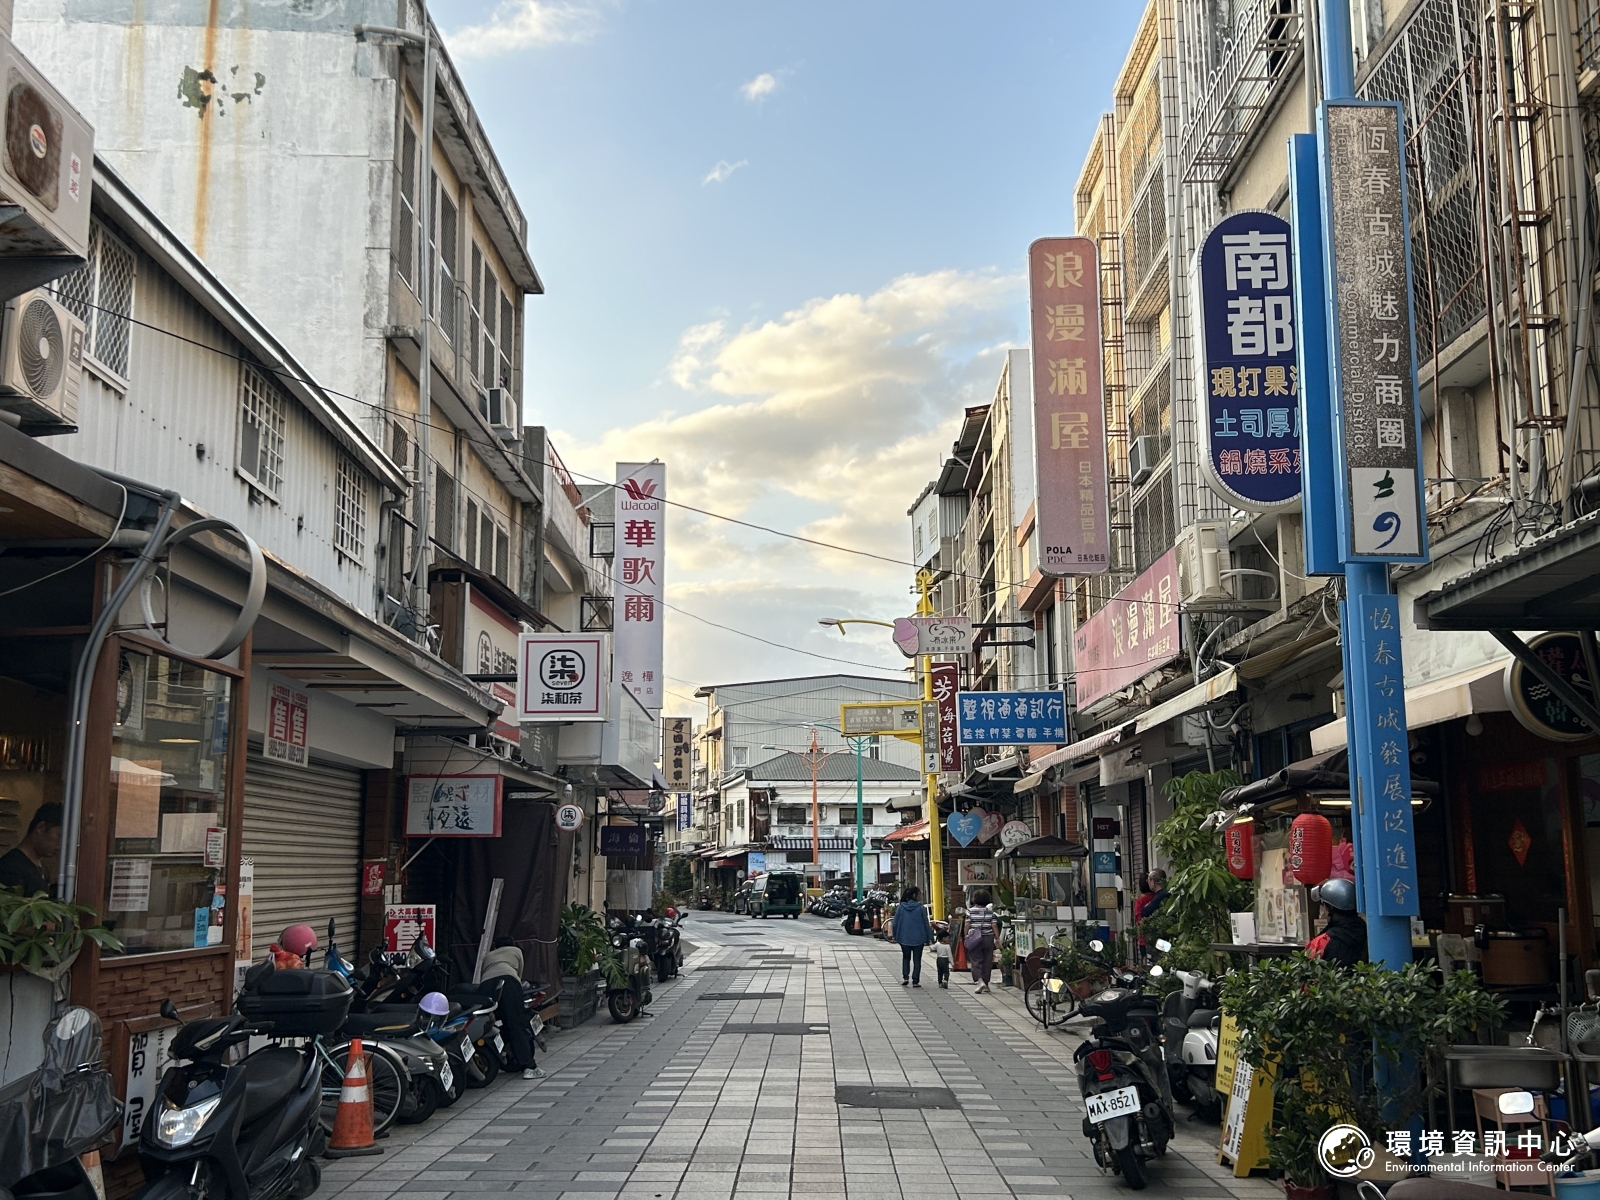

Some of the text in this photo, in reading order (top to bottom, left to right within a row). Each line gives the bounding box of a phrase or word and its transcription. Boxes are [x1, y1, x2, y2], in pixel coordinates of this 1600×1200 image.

[1222, 231, 1294, 356] 南都
[1359, 126, 1406, 449] 恆春古城魅力商圈
[1044, 251, 1090, 450] 浪漫滿屋
[1345, 291, 1363, 384] Commercial
[1214, 408, 1301, 438] 土司厚
[1351, 393, 1367, 449] District
[620, 500, 660, 511] Wacoal
[1079, 461, 1095, 544] 日本精品百貨
[1046, 546, 1072, 554] POLA
[1047, 555, 1067, 563] PDC
[622, 519, 656, 621] 華歌爾
[1112, 574, 1172, 659] 浪漫滿屋
[549, 655, 576, 680] 柒
[541, 692, 583, 705] 柒和茶
[962, 697, 1062, 720] 聲視通通訊行
[273, 700, 287, 740] 售
[292, 707, 305, 746] 售
[928, 711, 938, 750] 中山老街
[393, 919, 427, 951] 售
